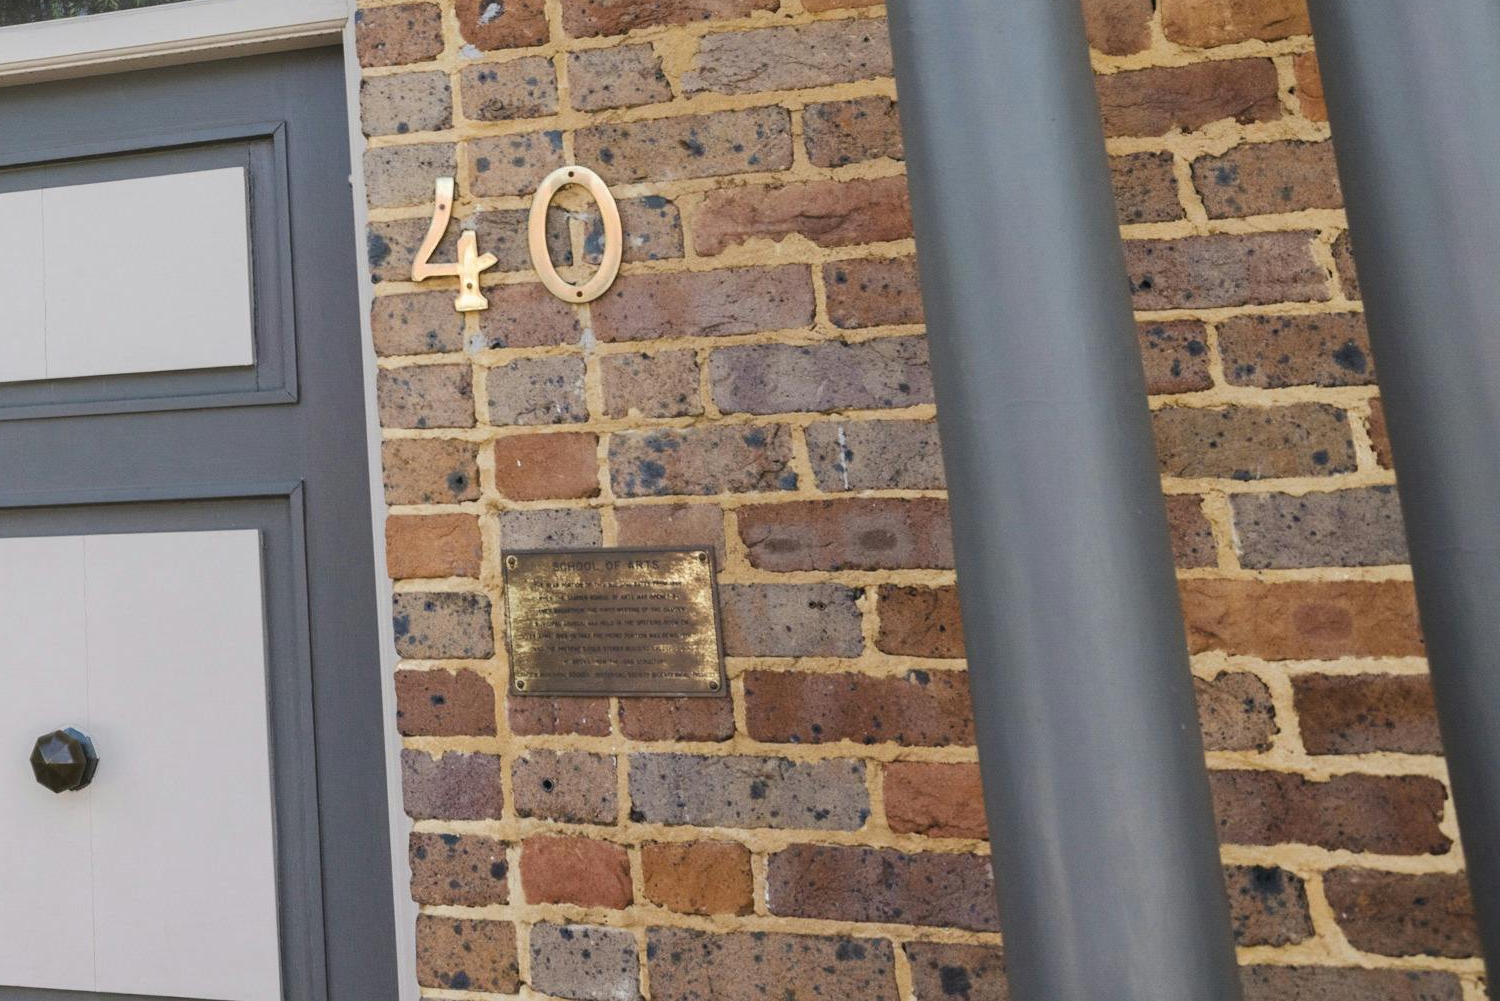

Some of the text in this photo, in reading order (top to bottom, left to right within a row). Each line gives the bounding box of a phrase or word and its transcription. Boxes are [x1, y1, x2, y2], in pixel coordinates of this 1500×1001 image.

[412, 166, 622, 312] 40
[553, 560, 660, 571] SCHOOL OF ARTS
